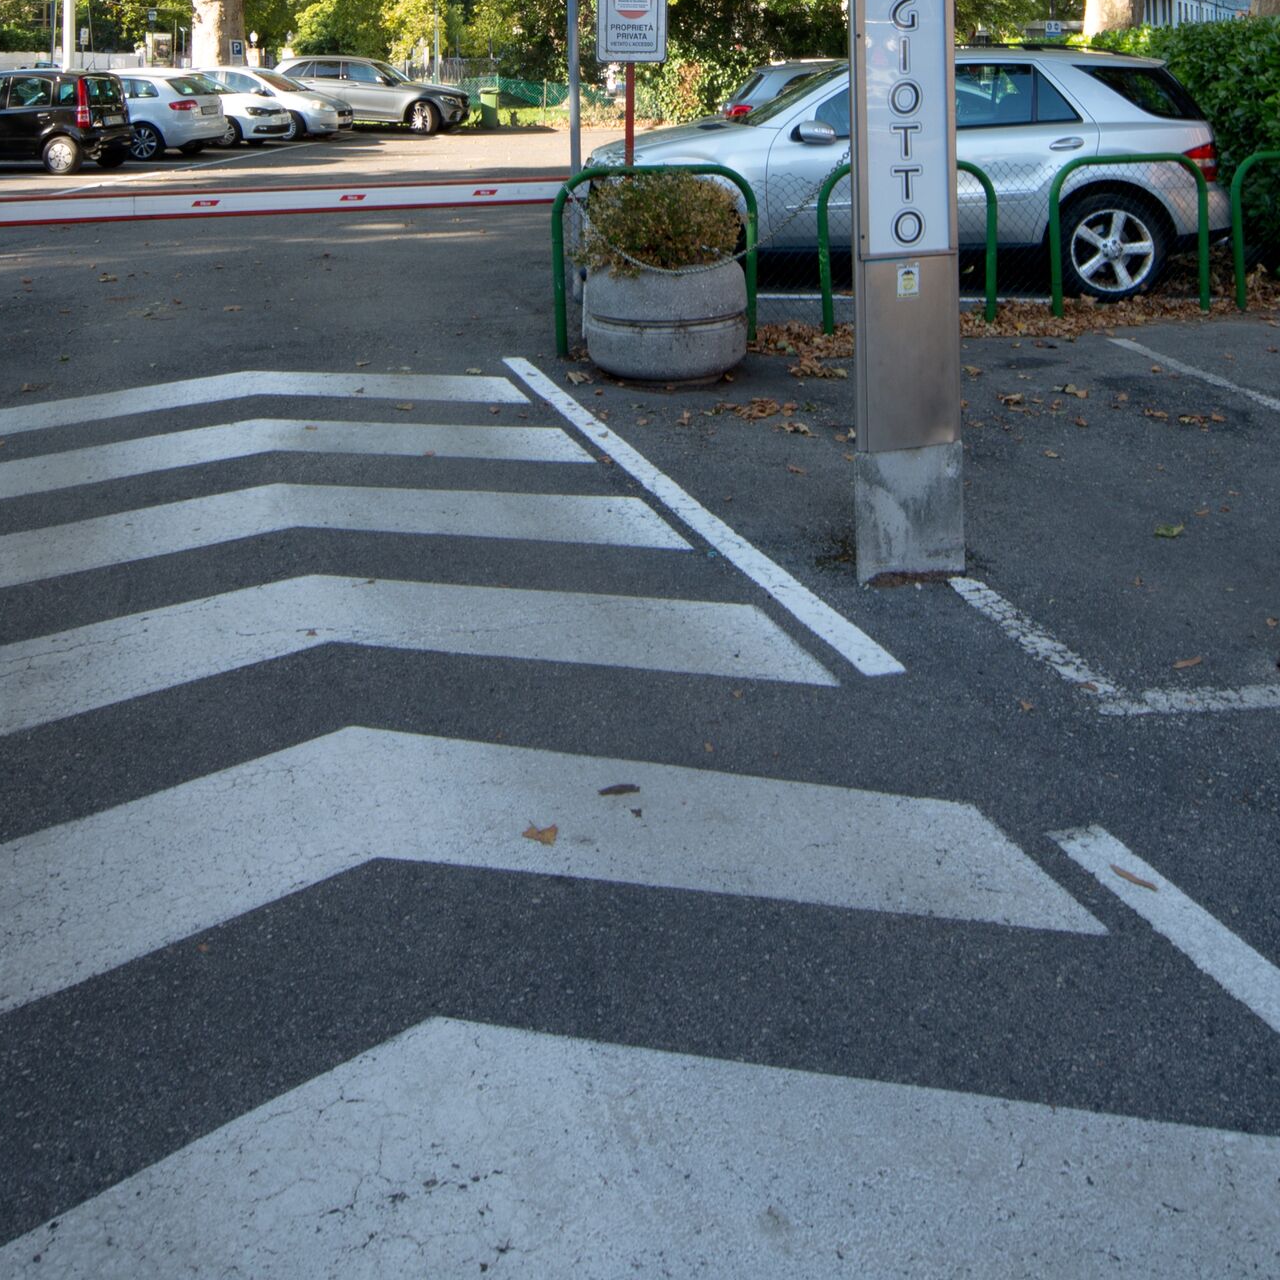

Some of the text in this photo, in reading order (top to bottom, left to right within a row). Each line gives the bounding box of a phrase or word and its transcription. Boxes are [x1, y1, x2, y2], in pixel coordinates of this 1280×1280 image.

[610, 22, 654, 32] PROPRIETÀ
[616, 32, 648, 40] PRIVATA
[233, 42, 241, 55] P
